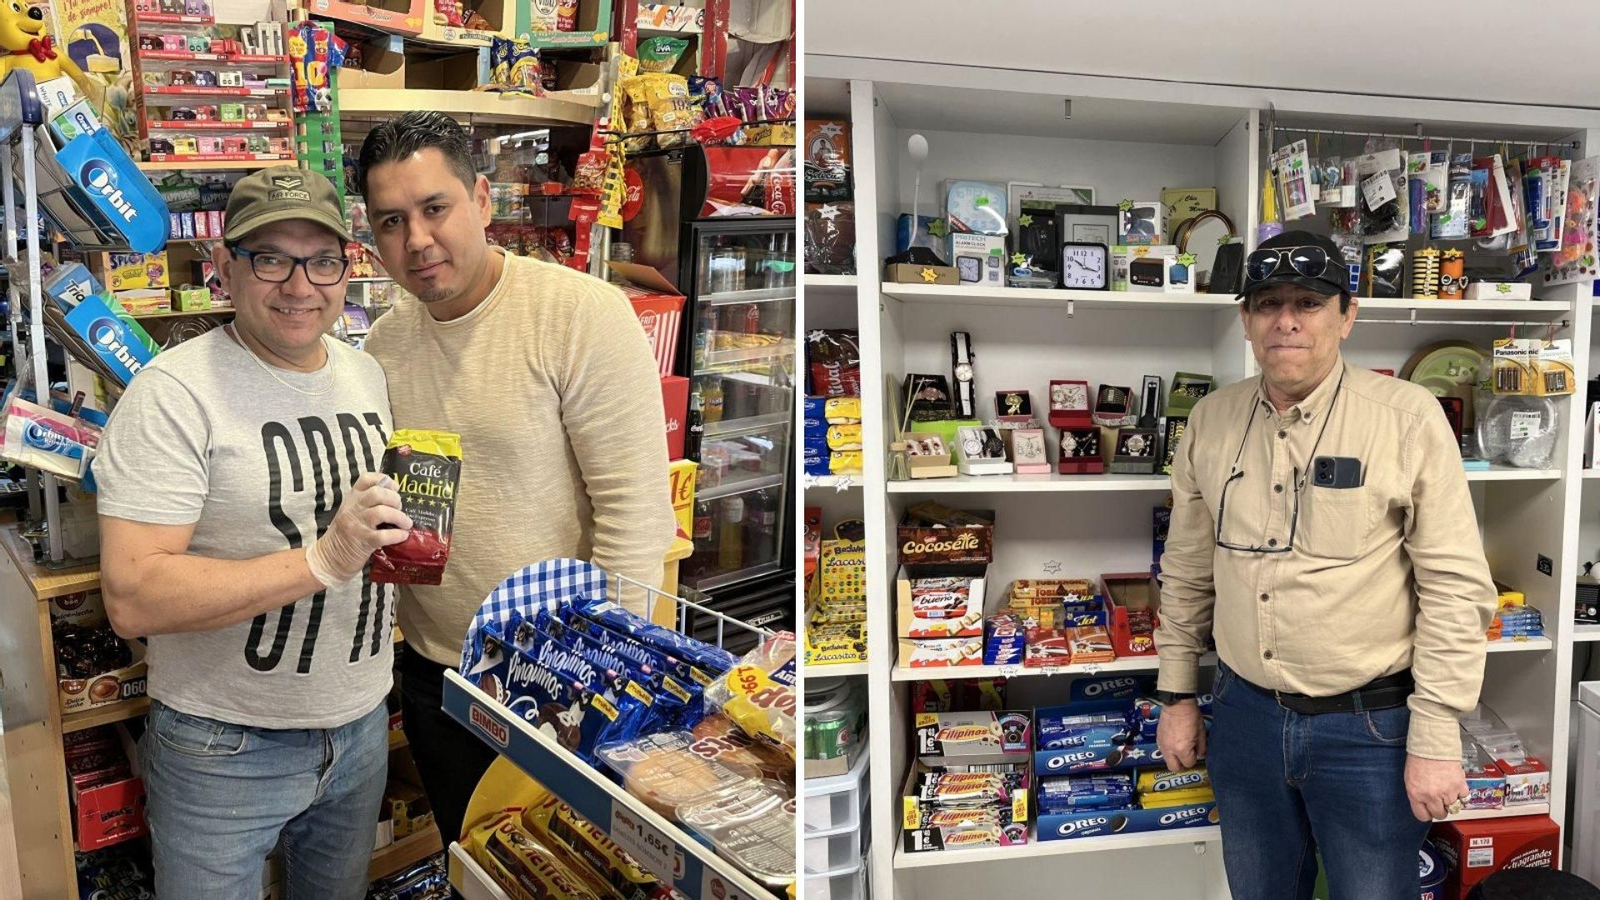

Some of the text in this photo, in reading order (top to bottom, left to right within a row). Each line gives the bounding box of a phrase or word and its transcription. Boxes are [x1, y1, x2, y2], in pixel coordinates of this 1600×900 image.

[82, 159, 138, 223] Orbit
[271, 190, 311, 200] AIR FORCE
[641, 315, 654, 325] FRIT
[88, 318, 143, 377] Orbit
[409, 462, 442, 479] Café
[393, 472, 455, 500] Madrid
[670, 470, 692, 504] 1€
[919, 596, 953, 605] bueno
[814, 652, 857, 661] Lacasitos
[1083, 677, 1136, 697] OREO
[471, 704, 508, 743] BIMBO
[935, 728, 989, 740] Filipinos
[1047, 751, 1096, 769] OREO
[941, 773, 992, 783] Filipinos
[1153, 773, 1201, 792] OREO
[936, 782, 988, 794] Filipinos
[930, 811, 987, 823] Filipinos
[1159, 806, 1207, 825] OREO
[1058, 816, 1108, 835] OREO
[945, 832, 990, 844] Filipinos
